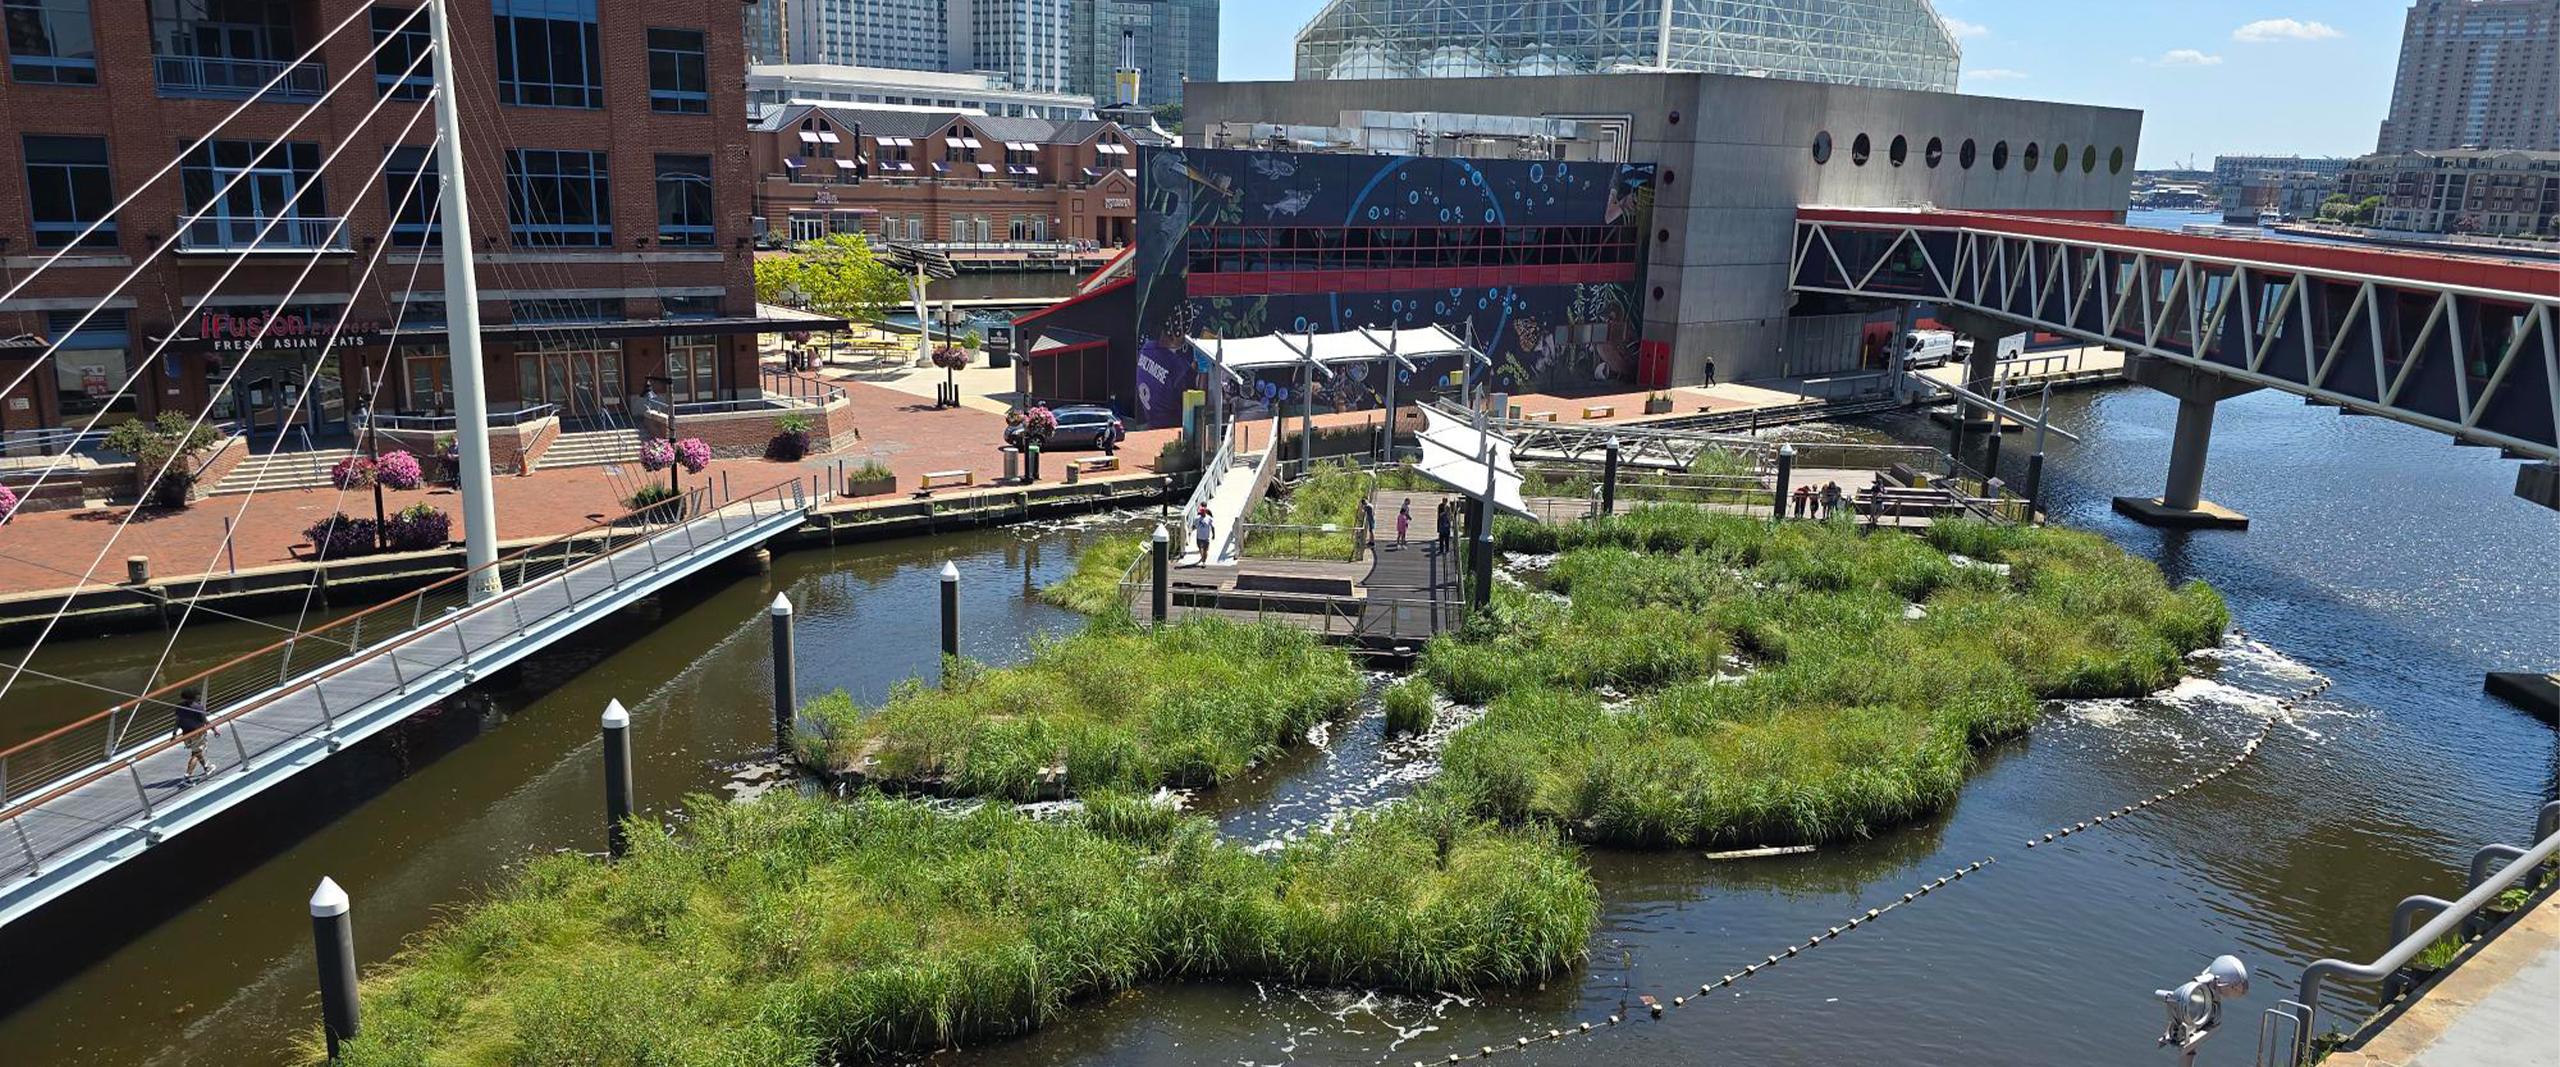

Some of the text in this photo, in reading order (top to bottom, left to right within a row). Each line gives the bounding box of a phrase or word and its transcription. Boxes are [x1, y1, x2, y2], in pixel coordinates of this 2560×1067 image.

[214, 336, 364, 350] FRESH ASIAN EATS
